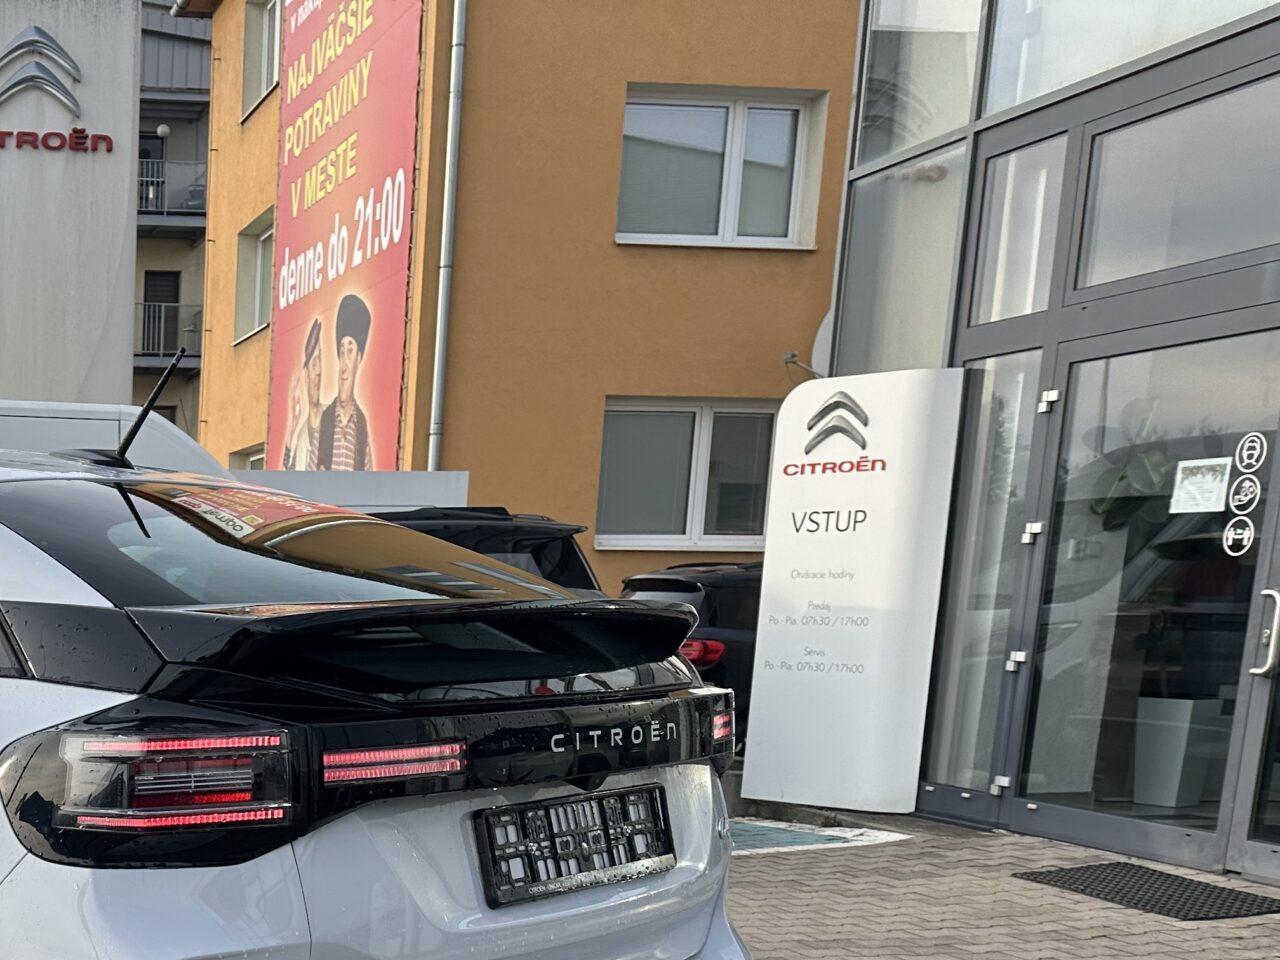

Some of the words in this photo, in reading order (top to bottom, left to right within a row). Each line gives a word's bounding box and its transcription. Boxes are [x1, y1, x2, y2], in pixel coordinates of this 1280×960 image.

[284, 51, 374, 167] POTRAVINY
[291, 177, 302, 218] V
[304, 132, 358, 211] MESTE
[279, 240, 324, 310] denne
[327, 212, 349, 283] do
[352, 167, 406, 269] 21:00
[791, 509, 868, 533] VSTUP
[801, 615, 830, 626] 07h30
[840, 616, 870, 627] 17h00
[803, 646, 826, 657] Servis
[796, 661, 825, 672] 07h30
[835, 663, 865, 674] 17h00
